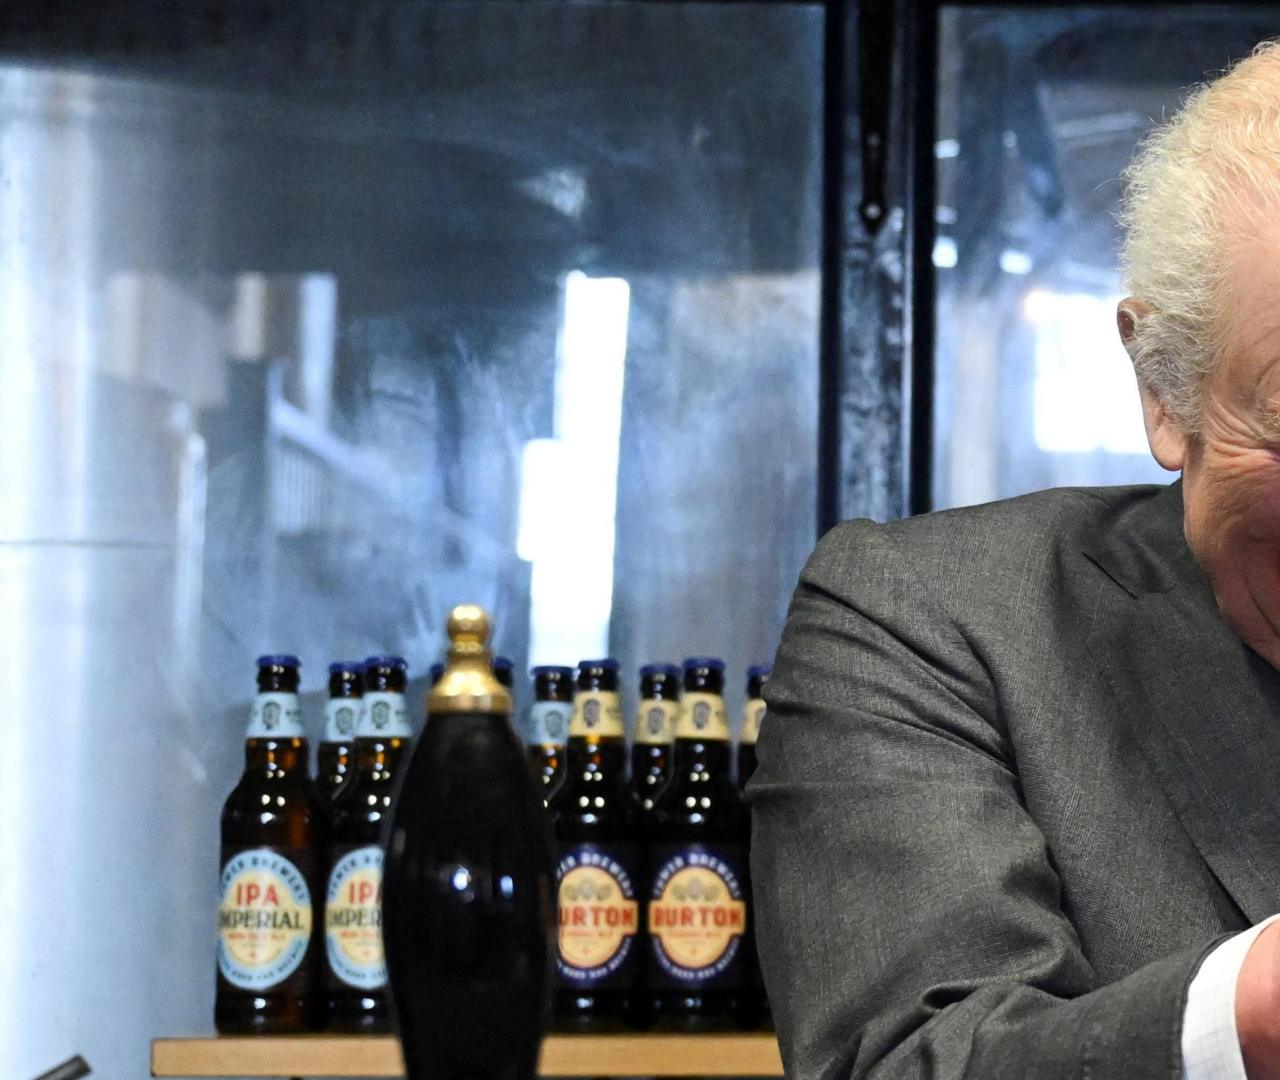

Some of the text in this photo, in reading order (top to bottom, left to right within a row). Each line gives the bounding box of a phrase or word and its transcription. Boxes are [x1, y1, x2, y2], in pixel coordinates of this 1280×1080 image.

[235, 882, 279, 906] IPA
[559, 904, 636, 927] URTON
[654, 905, 741, 927] BURTON
